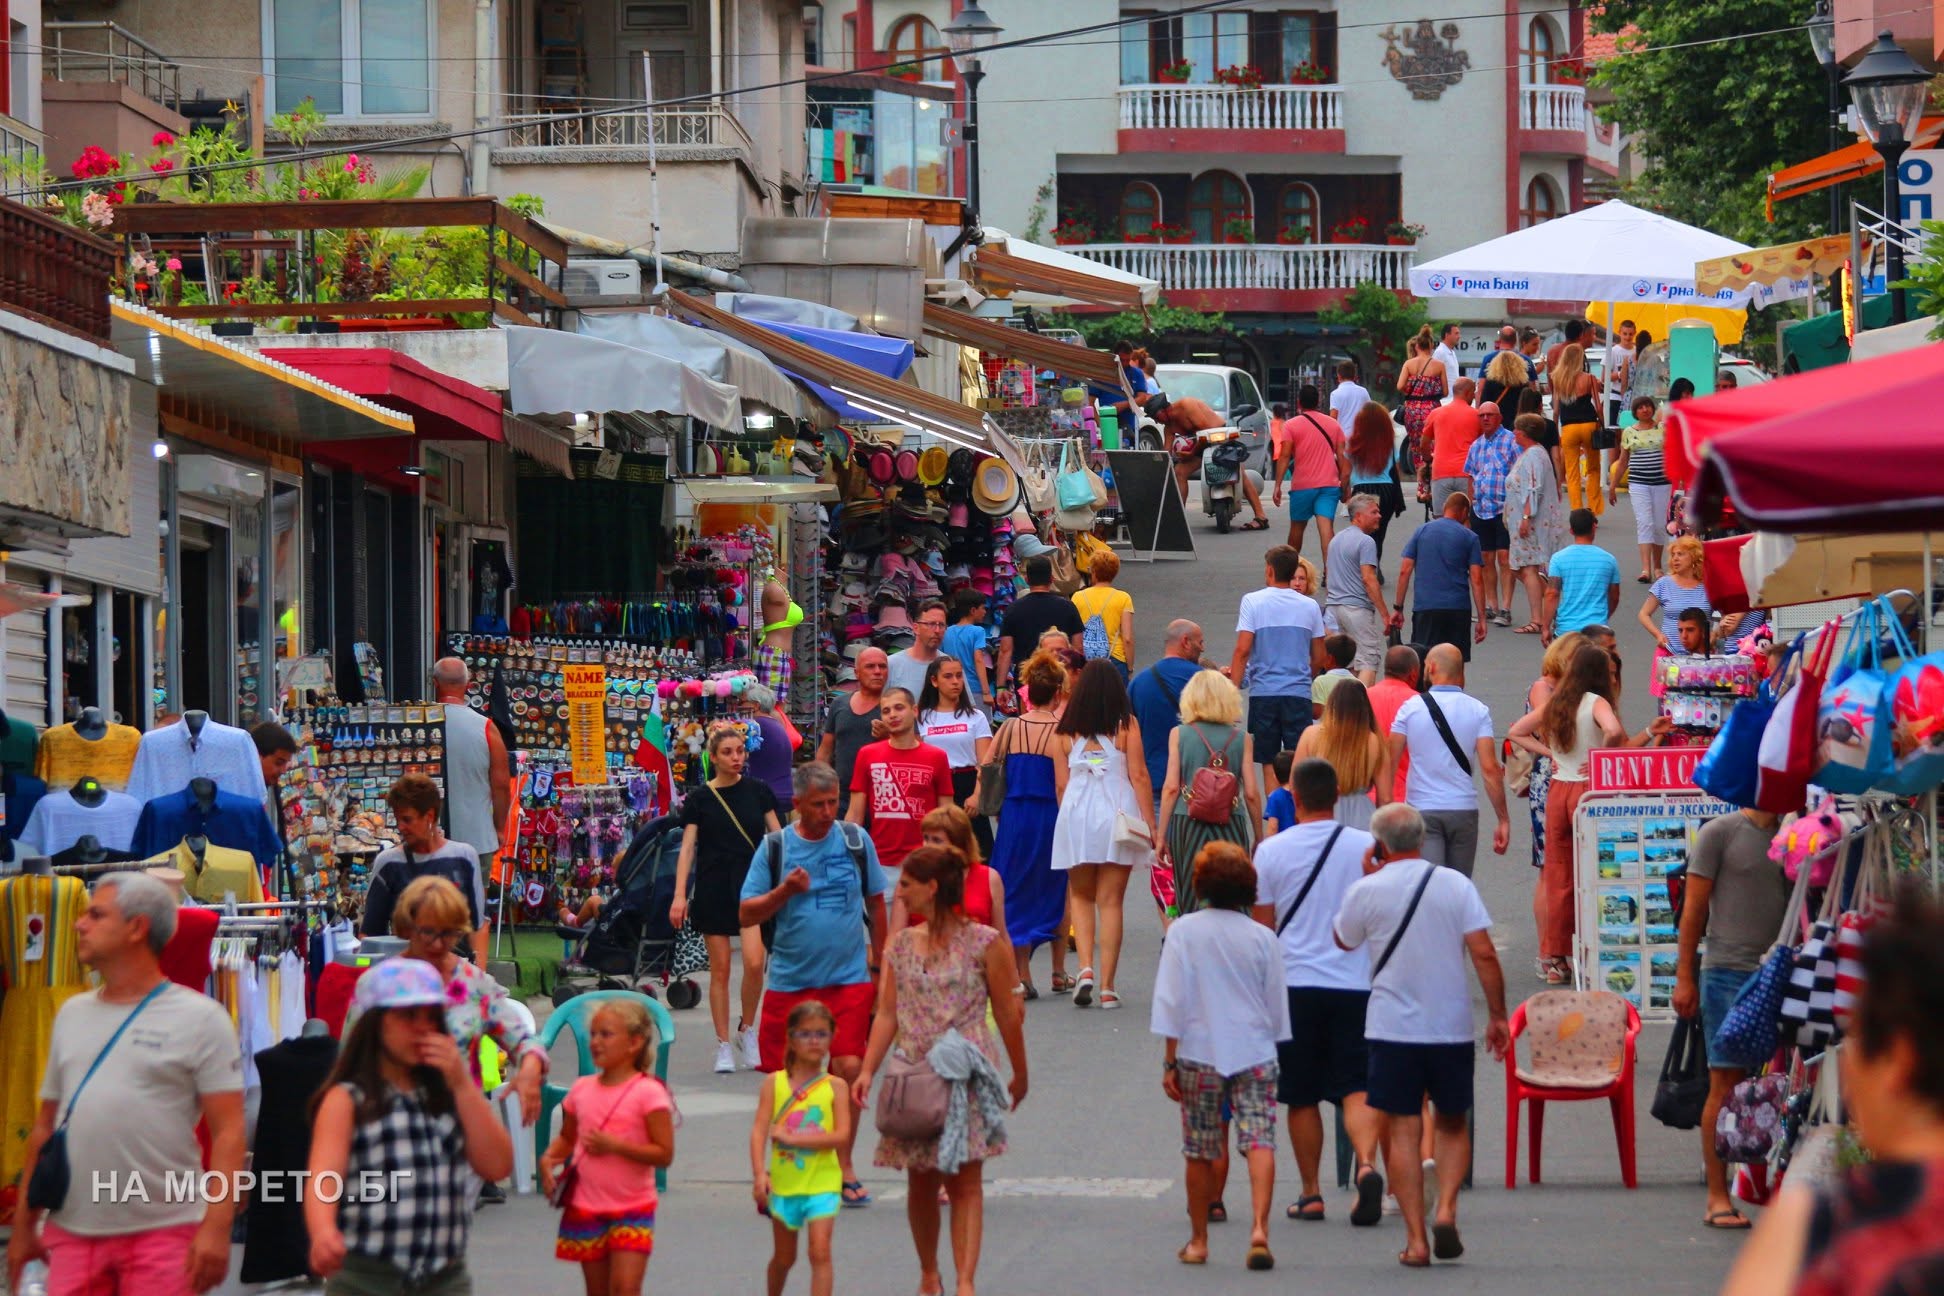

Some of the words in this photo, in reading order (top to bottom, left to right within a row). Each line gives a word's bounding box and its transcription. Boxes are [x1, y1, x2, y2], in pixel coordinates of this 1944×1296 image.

[1452, 276, 1490, 292] Горна
[1494, 277, 1529, 290] Баня
[1656, 282, 1694, 299] Горна
[566, 672, 603, 684] NAME
[567, 690, 603, 698] BRACELET
[871, 768, 932, 785] SUPER
[1601, 756, 1653, 787] RENT
[1661, 755, 1671, 786] A
[1586, 805, 1664, 818] МЕРОПРИЯТИЯ
[1668, 805, 1676, 816] И
